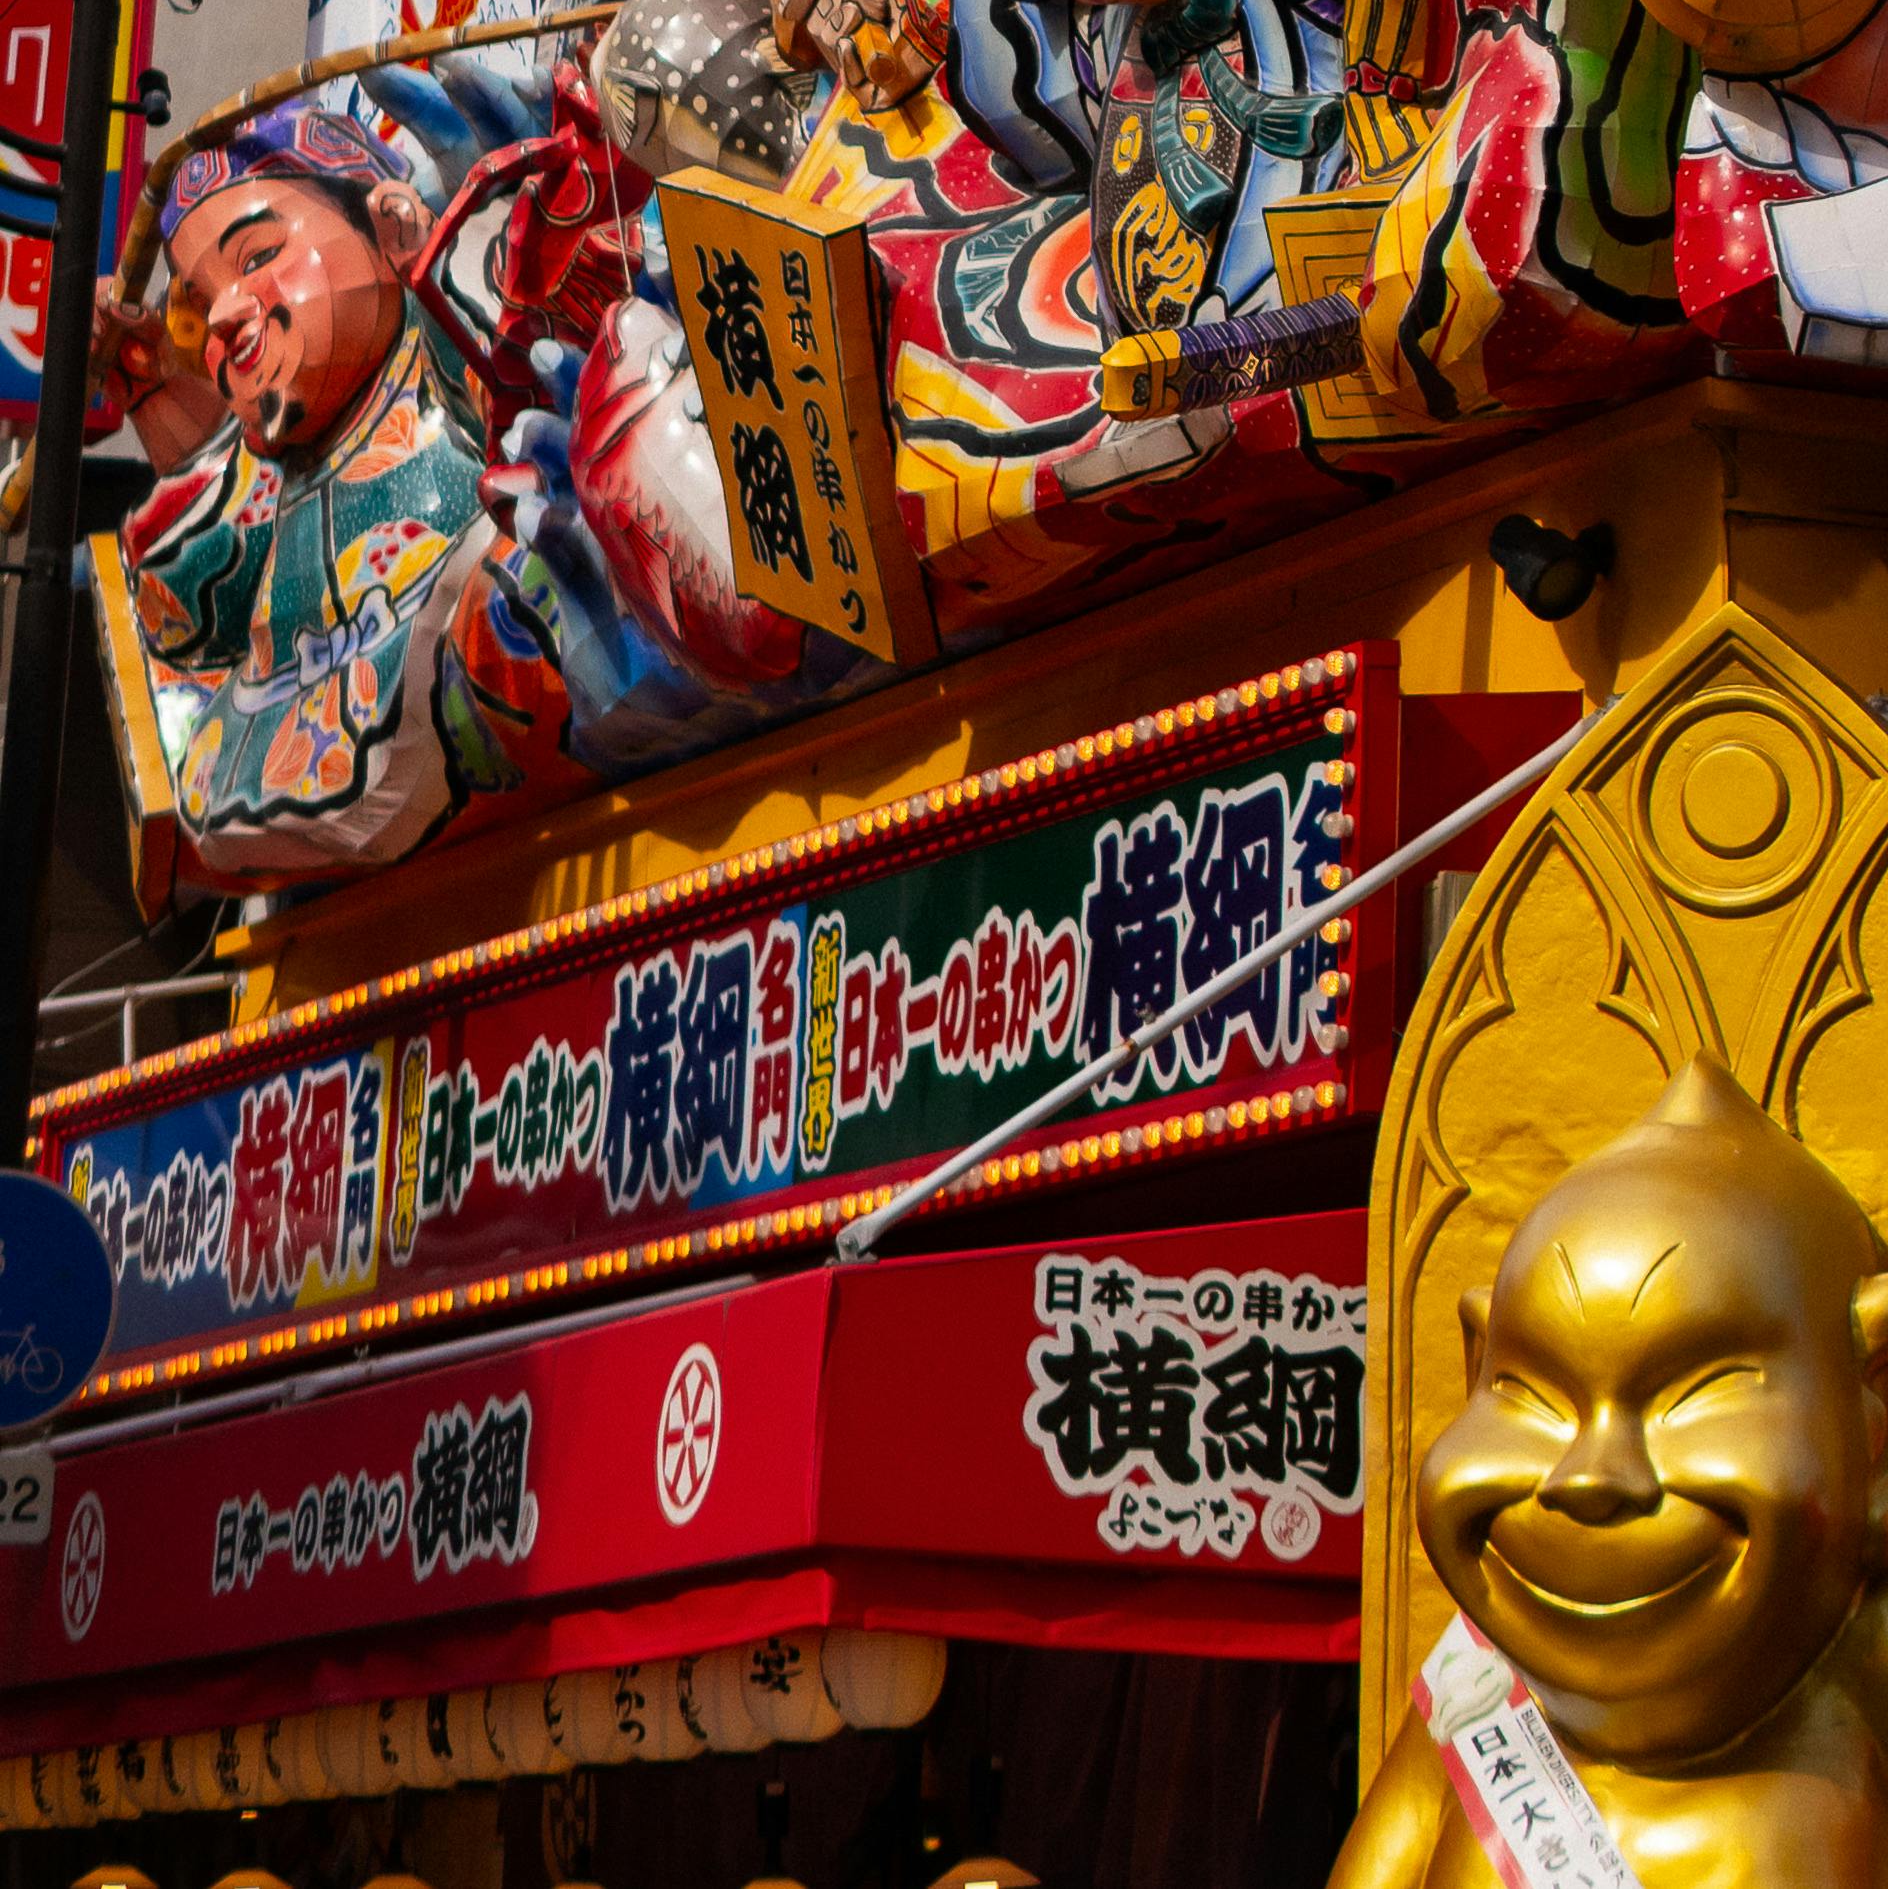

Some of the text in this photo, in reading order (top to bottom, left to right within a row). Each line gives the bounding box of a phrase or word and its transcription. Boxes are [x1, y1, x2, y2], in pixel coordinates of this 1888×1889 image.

[780, 248, 866, 634] 日本一の串かつ
[749, 936, 796, 1168] 名門
[803, 928, 841, 1159] 新世界
[840, 788, 1284, 1107] 日本一の串かつ 横綱
[229, 1074, 347, 1302] 横綱
[341, 1067, 382, 1276] 名門
[394, 1052, 428, 1252] 新世界
[421, 943, 750, 1207] 日本一の串かつ 横綱
[214, 1474, 403, 1588] 日本一の串かつ
[412, 1405, 529, 1567] 横綱
[1037, 1322, 1365, 1500] 横綱
[1108, 1492, 1248, 1546] よこづな
